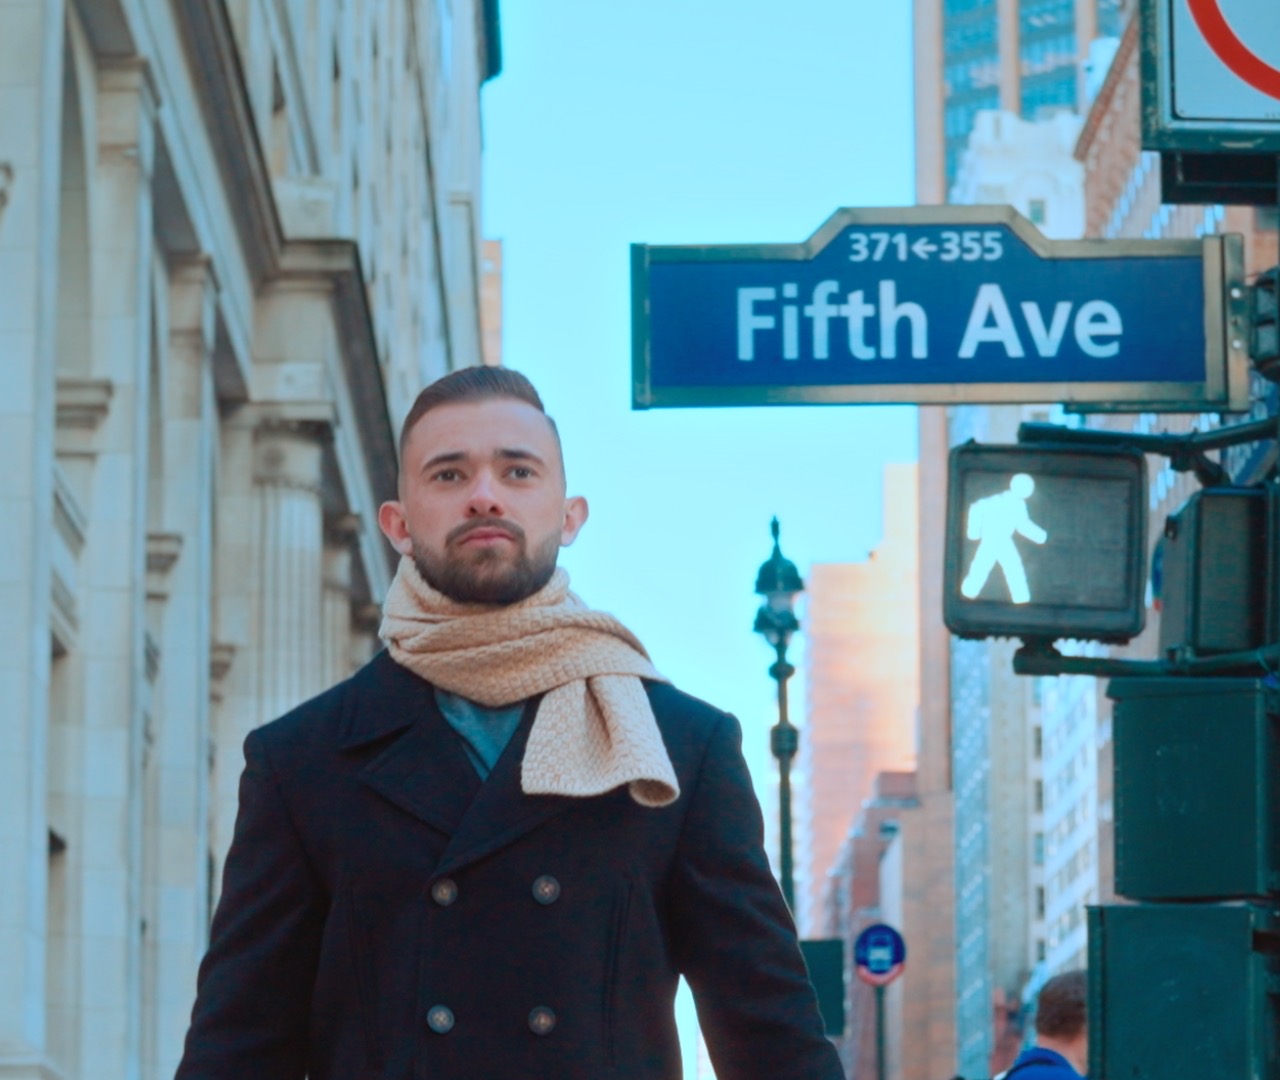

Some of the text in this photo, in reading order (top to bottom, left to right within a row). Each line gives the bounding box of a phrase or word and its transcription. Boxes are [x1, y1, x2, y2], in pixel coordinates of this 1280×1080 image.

[849, 231, 1003, 262] 371 355
[737, 280, 1123, 361] Fifth Ave
